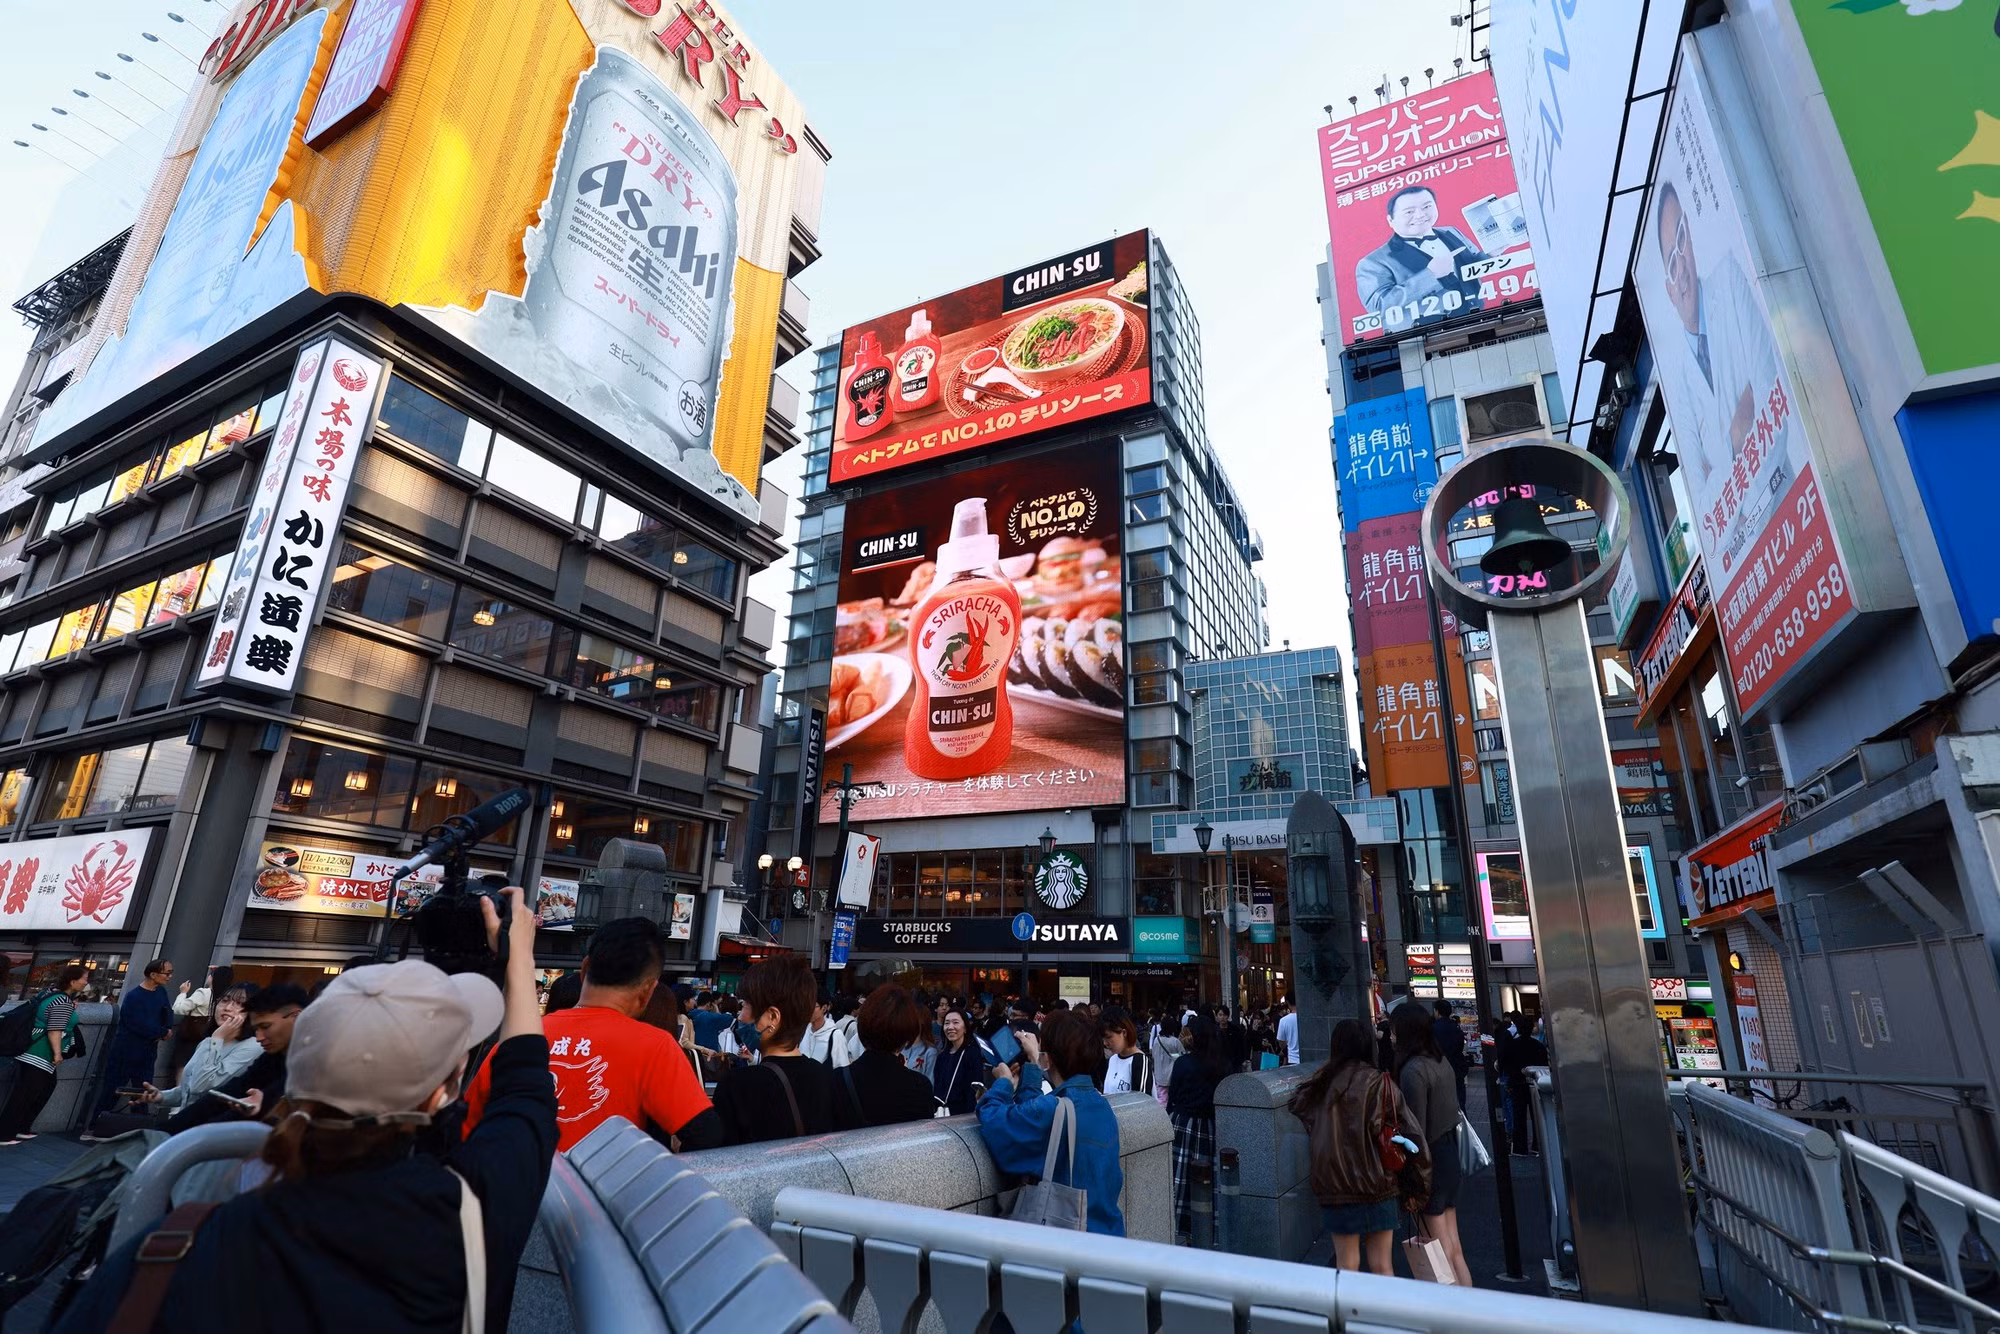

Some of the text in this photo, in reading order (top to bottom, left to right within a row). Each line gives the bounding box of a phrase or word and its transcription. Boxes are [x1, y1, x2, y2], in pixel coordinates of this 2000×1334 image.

[329, 5, 401, 86] 1889
[311, 51, 386, 133] OSAKA
[633, 89, 661, 113] KARA
[1327, 96, 1450, 150] スーパー
[644, 133, 693, 184] SUPER
[1333, 124, 1501, 190] SUPER MILLION
[577, 160, 720, 300] Asahi
[571, 215, 589, 230] VISION
[588, 226, 597, 235] OF
[596, 229, 626, 254] JAPANESE
[665, 286, 689, 308] MASTER
[573, 206, 595, 223] QUALITY
[594, 218, 628, 247] STANDARDS,
[667, 277, 688, 296] UNDER
[687, 295, 698, 308] THE
[576, 197, 591, 209] ASAHI
[591, 206, 610, 221] SUPER
[609, 219, 623, 231] DRY
[622, 229, 629, 237] IS
[628, 234, 655, 258] BREWED
[654, 254, 670, 272] WITH
[669, 269, 696, 296] PRECISION
[694, 292, 703, 303] TO
[567, 233, 588, 251] DELIVER
[587, 246, 594, 254] A
[605, 258, 625, 276] CRISP
[624, 272, 643, 292] TASTE
[641, 286, 657, 301] AND
[676, 315, 693, 334] CLEAN
[569, 224, 580, 235] OUR
[578, 229, 606, 252] ADVANCED
[664, 293, 676, 306] ING
[675, 302, 708, 338] TECHNIQUES
[627, 248, 664, 295] 生
[1012, 251, 1101, 295] CHIN-SU
[1466, 258, 1512, 278] ルアン
[594, 275, 681, 348] スーパードライ
[1384, 269, 1540, 326] 0120-494
[608, 342, 649, 377] 生ビール
[853, 369, 886, 388] CHIN-SU
[902, 381, 926, 392] CHIN-SU
[680, 390, 707, 430] お酒
[264, 390, 305, 494] 本場の味
[303, 397, 353, 503] 本場の味
[1348, 422, 1414, 459] 龍角散
[1346, 448, 1415, 485] ダイレクト
[1712, 377, 1791, 540] 東京美容外科
[1021, 501, 1086, 529] NO.1の
[1029, 491, 1077, 508] ベトナムで
[1029, 522, 1076, 540] チリソース
[1463, 514, 1494, 531] 大阪
[860, 531, 918, 557] CHIN-SU
[1722, 480, 1817, 638] 大阪駅前第1ビル 2F
[1359, 574, 1423, 608] ダイレク
[932, 597, 1002, 629] SRIRACHA
[1743, 562, 1844, 692] 0120-658-958
[931, 702, 993, 725] CHIN-SU
[1372, 711, 1440, 744] ダイレク
[804, 718, 821, 804] TSUTAYA
[1250, 761, 1280, 773] なんば
[1256, 833, 1287, 845] BASH
[41, 873, 61, 884] おいしさ
[319, 879, 369, 897] 焼かに
[366, 862, 420, 881] かにき
[37, 885, 57, 895] 年中無休
[882, 922, 952, 933] STARBUCKS
[894, 934, 938, 944] COFFEE
[1031, 924, 1119, 942] TSUTAYA
[1139, 931, 1180, 942] @cosme
[1147, 968, 1173, 976] Gotta Be
